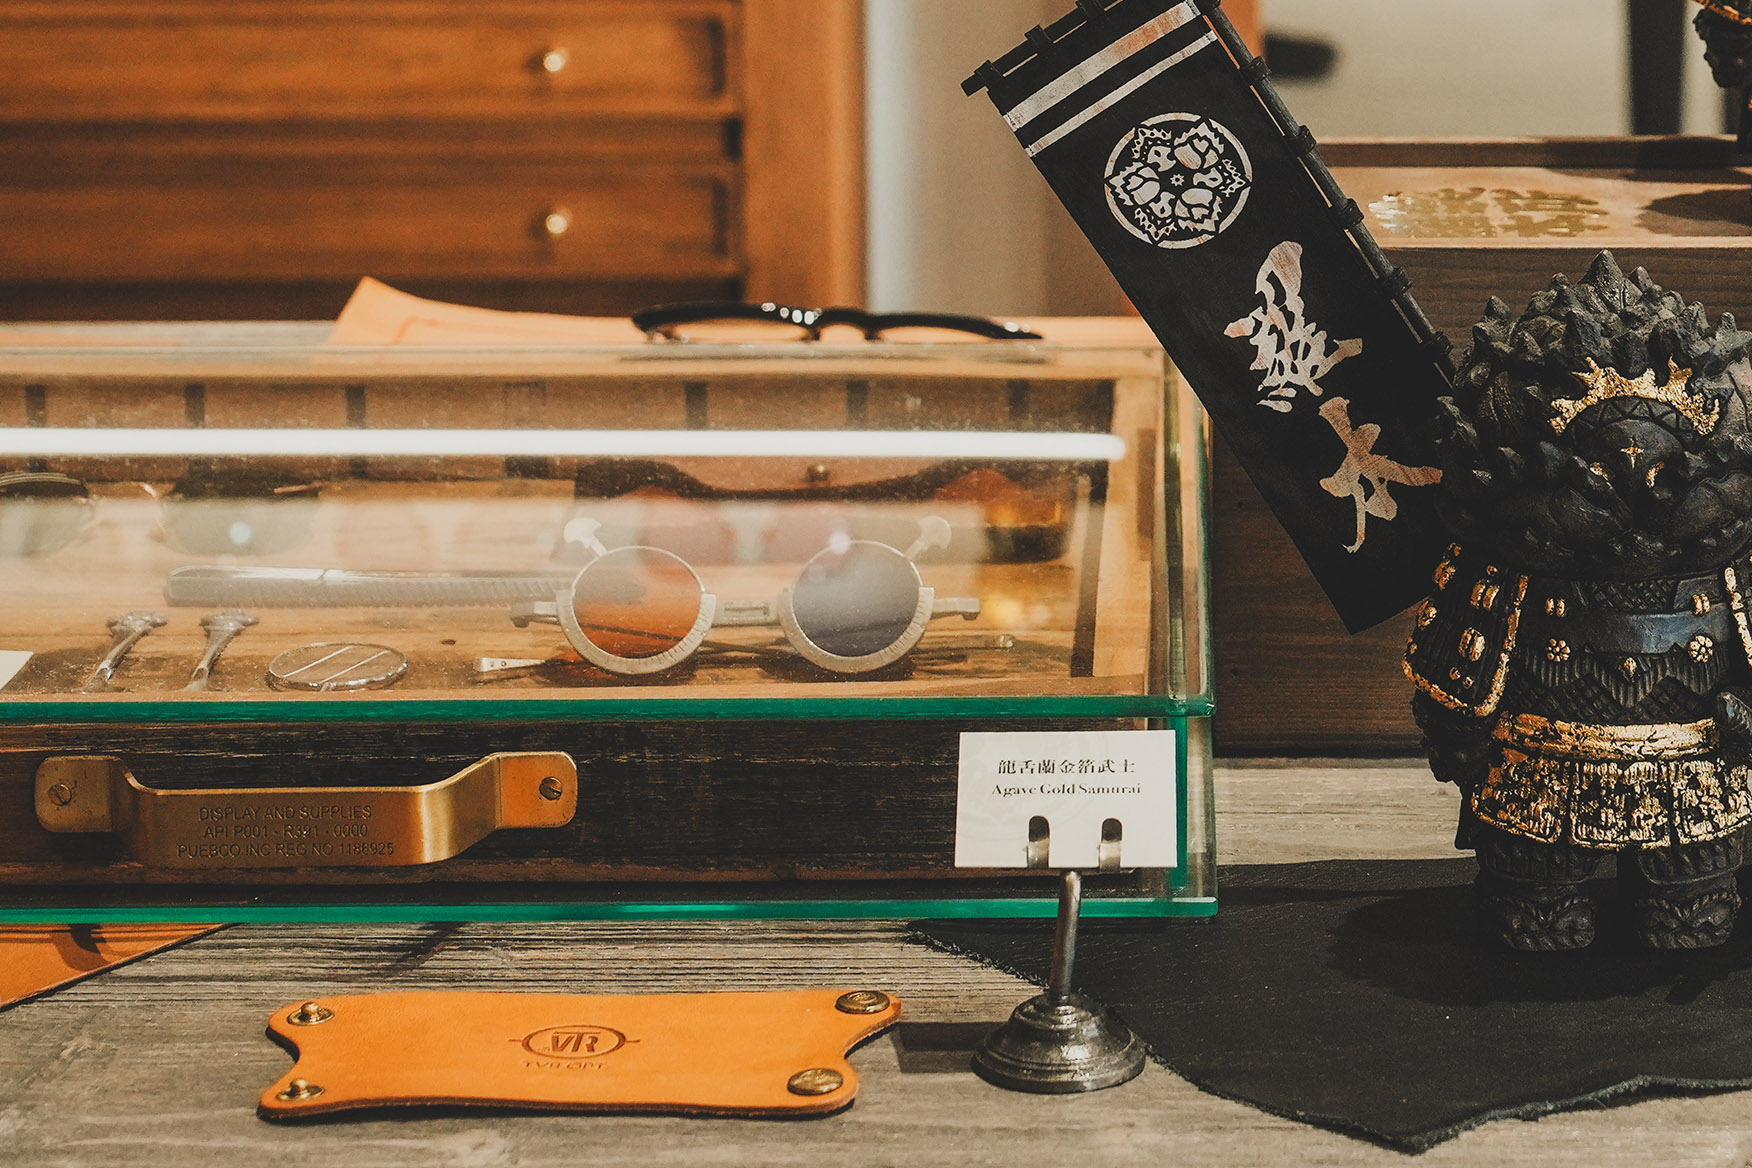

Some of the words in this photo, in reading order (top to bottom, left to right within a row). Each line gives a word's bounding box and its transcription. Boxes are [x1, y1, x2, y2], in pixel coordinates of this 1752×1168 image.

[998, 759, 1136, 775] 龍舌蘭金箔武士
[991, 784, 1038, 798] Agave
[1040, 784, 1076, 795] Gold
[1078, 782, 1142, 795] Samurai
[199, 807, 260, 821] DISPLAY
[264, 806, 296, 820] AND
[300, 805, 372, 820] SUPPLIES
[233, 824, 268, 838] P001
[334, 824, 369, 838] 0000
[177, 843, 241, 858] PUEBCO
[245, 843, 272, 857] INC
[276, 843, 308, 857] REG
[312, 843, 334, 857] NO
